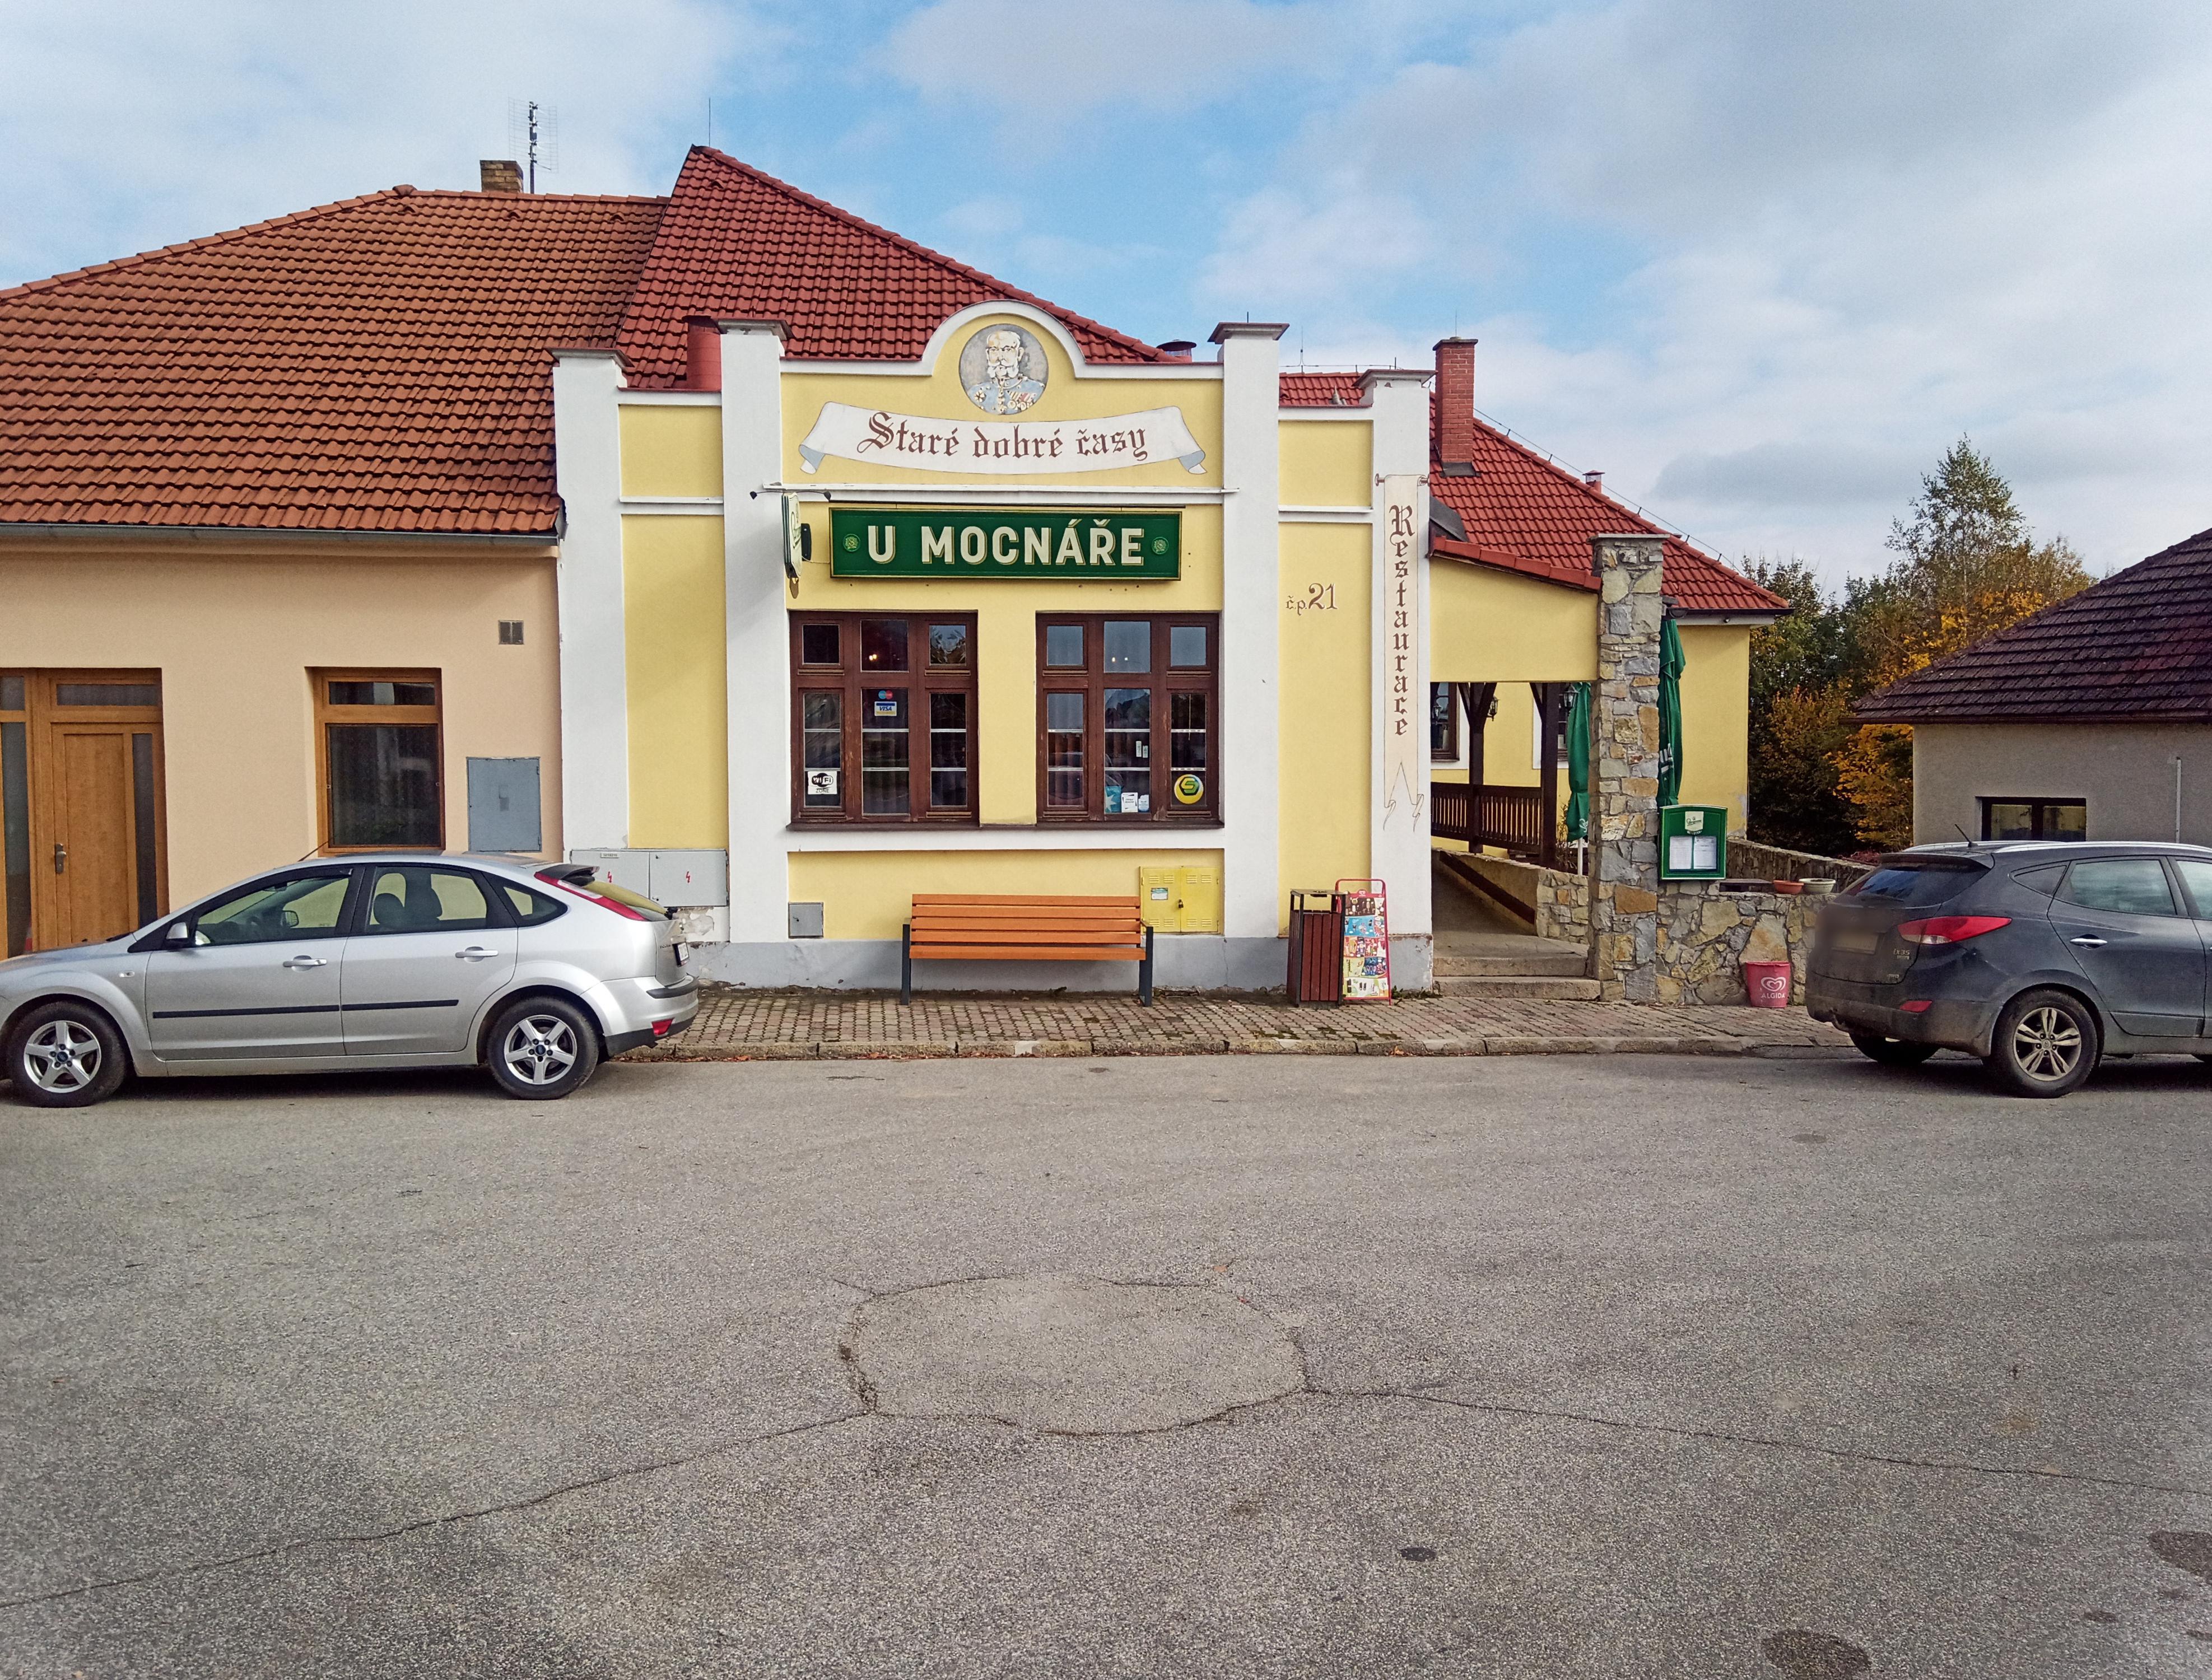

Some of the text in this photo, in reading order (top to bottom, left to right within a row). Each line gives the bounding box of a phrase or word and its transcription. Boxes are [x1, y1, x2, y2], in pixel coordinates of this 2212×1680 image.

[856, 412, 1148, 461] Staré dobré časy
[868, 519, 1144, 566] U MOCNÁŘE
[1389, 505, 1415, 736] Restaurace
